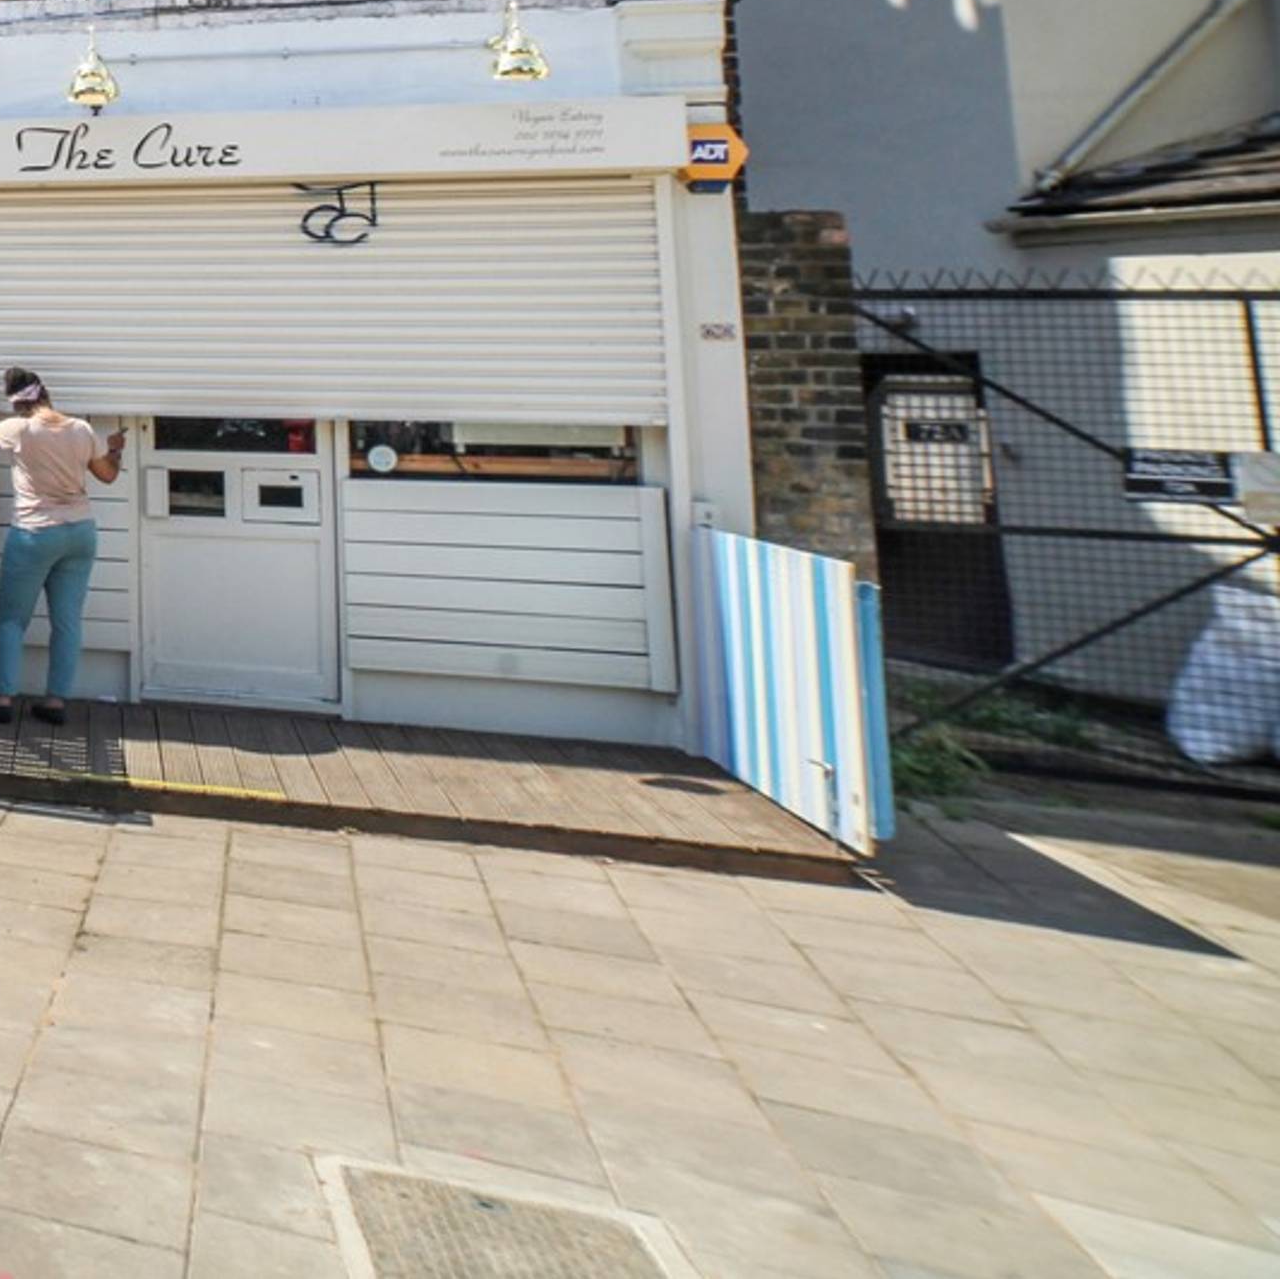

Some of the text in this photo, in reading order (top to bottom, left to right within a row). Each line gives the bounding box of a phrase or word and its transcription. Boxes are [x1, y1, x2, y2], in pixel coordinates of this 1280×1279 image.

[15, 122, 242, 172] The Cure
[690, 143, 728, 161] ADT
